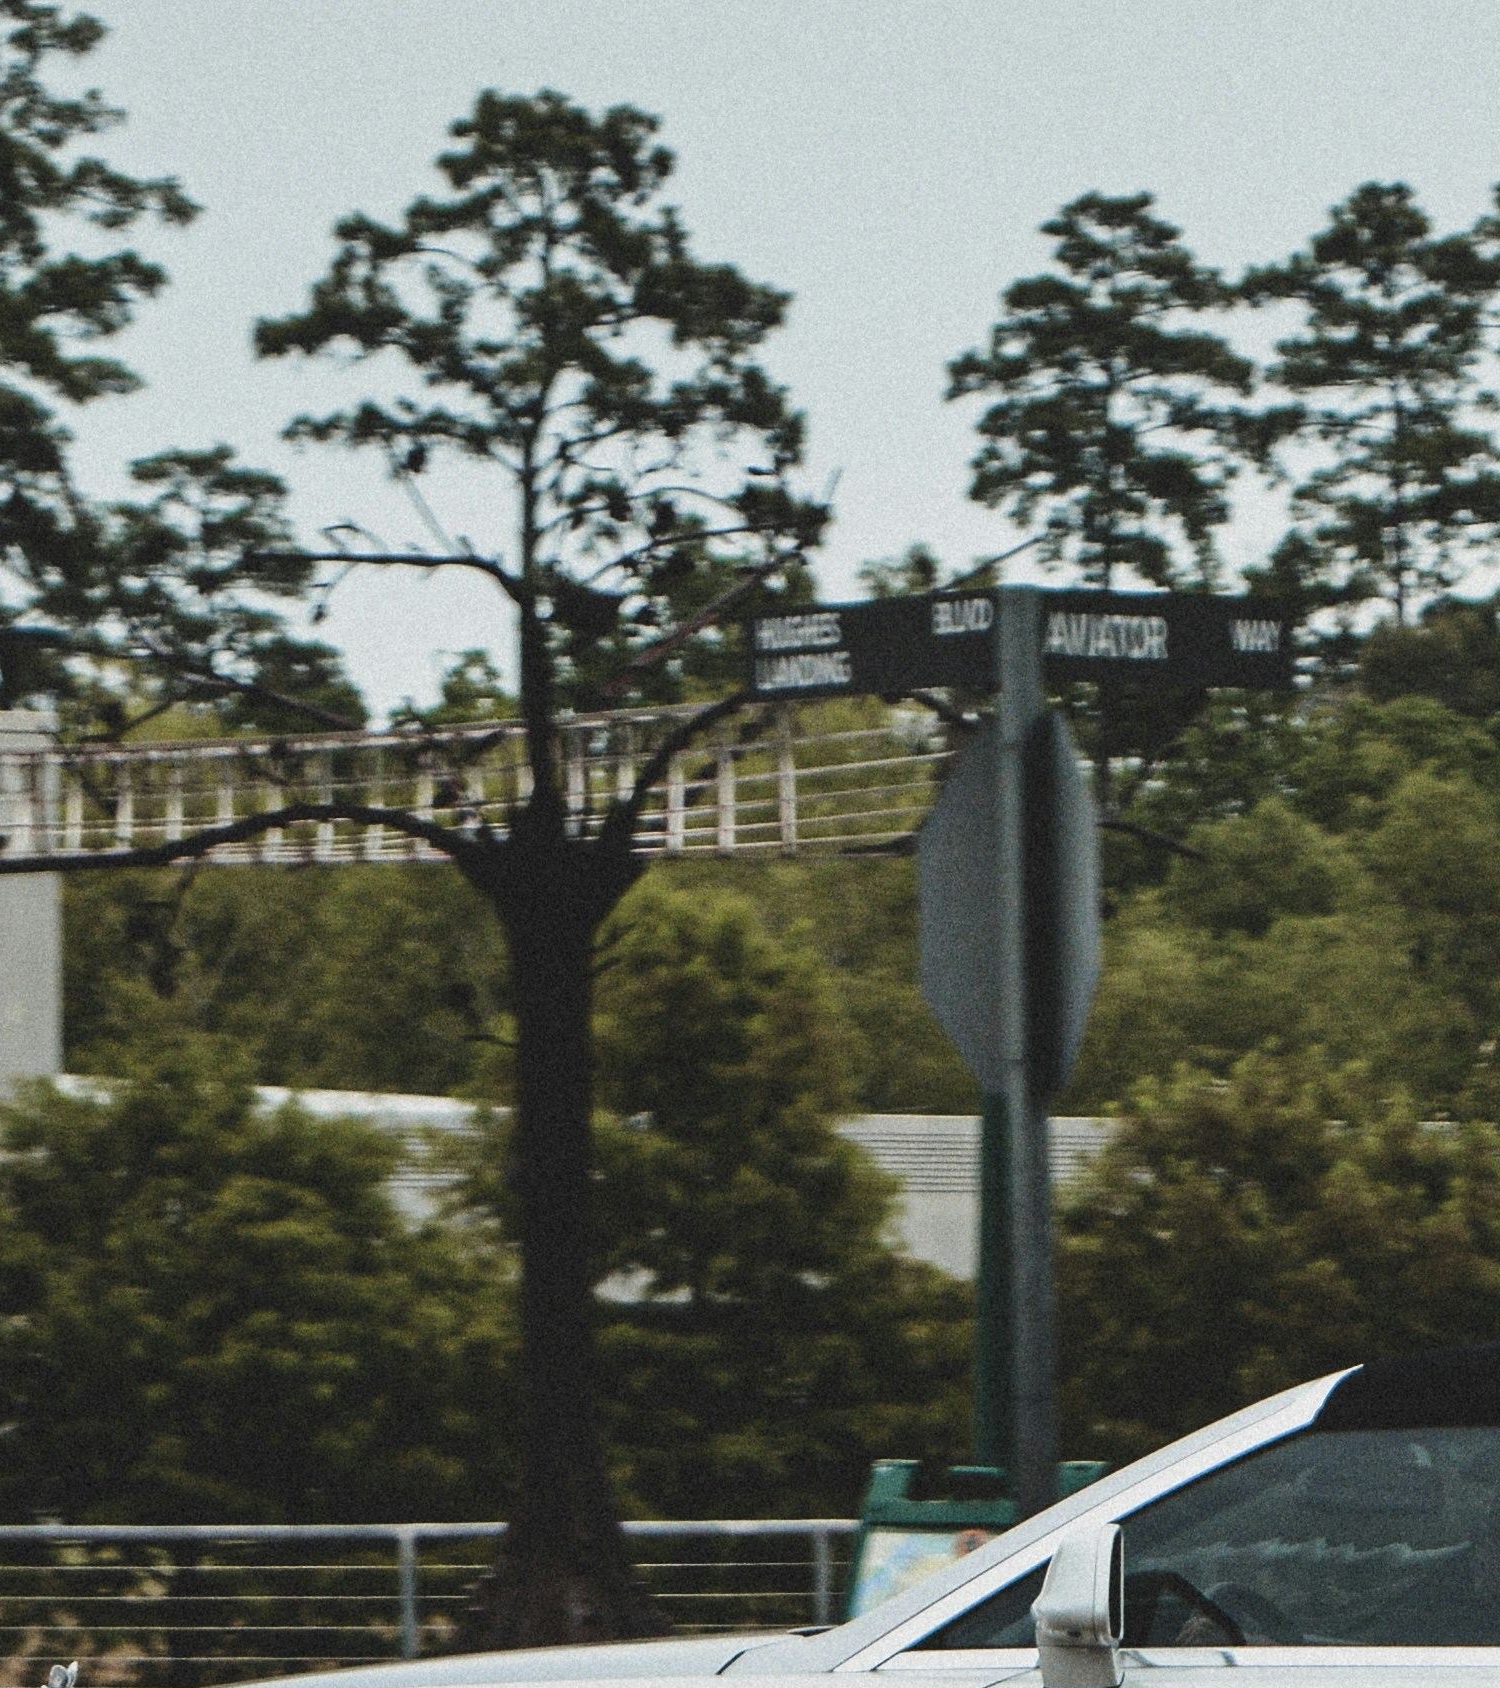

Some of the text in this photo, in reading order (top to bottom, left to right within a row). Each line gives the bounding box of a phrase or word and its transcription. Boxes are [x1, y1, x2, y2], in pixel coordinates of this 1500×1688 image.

[1043, 611, 1282, 660] AVIATOR WAY
[756, 651, 851, 690] LANDING
